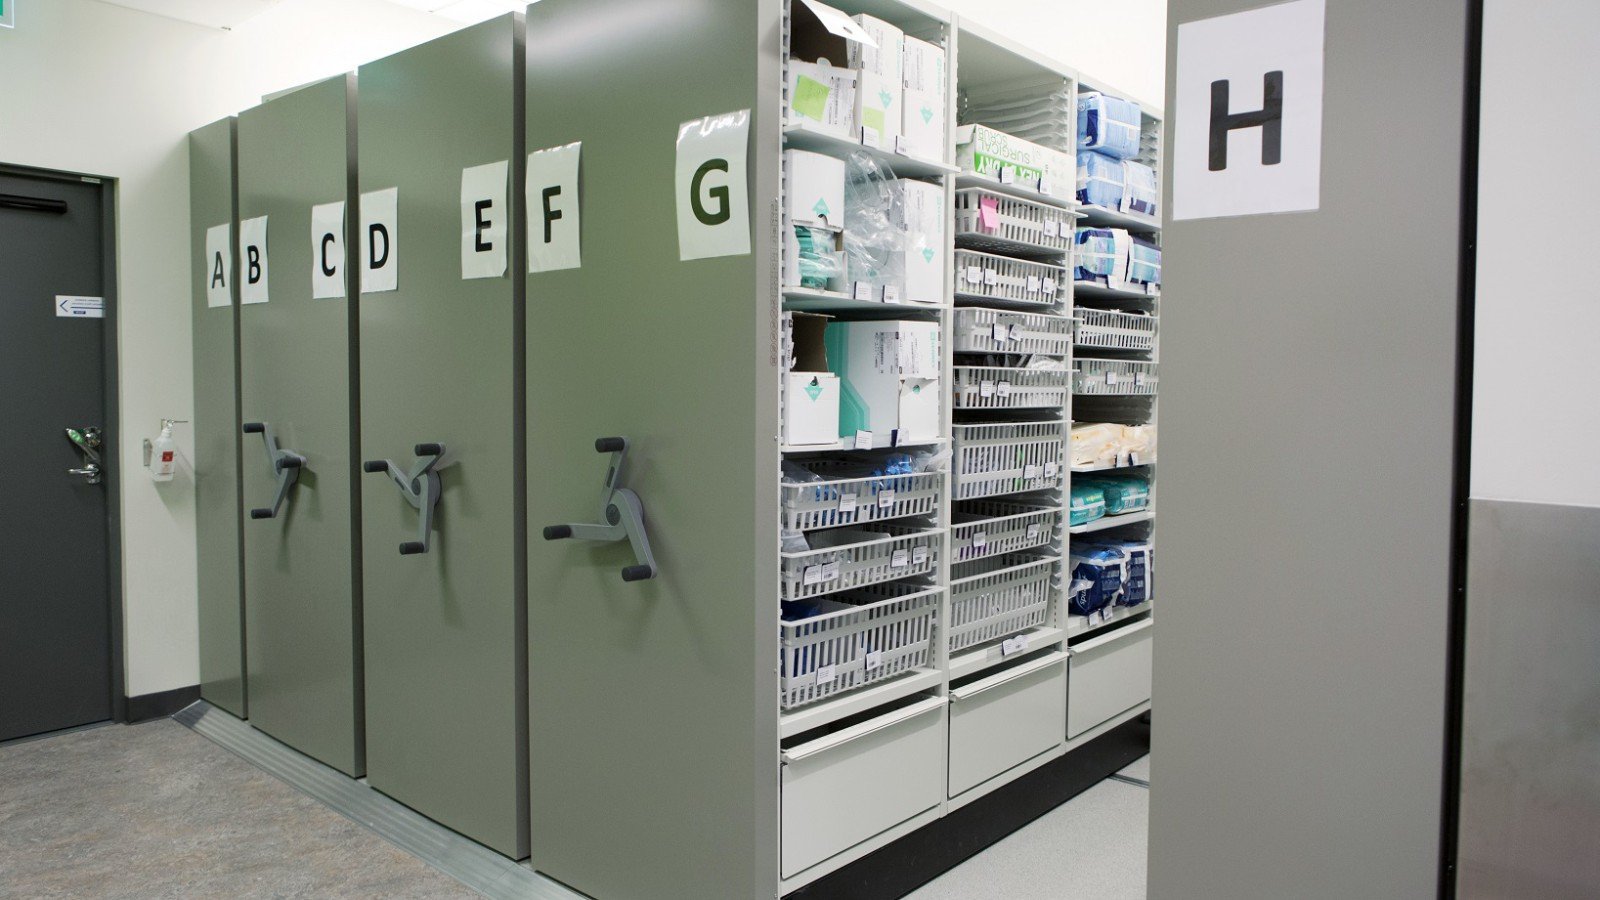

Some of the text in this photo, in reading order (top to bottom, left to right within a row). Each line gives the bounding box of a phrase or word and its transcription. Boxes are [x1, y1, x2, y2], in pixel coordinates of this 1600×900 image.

[978, 127, 1008, 147] SCRUB
[1208, 71, 1283, 172] H
[977, 137, 1030, 165] SURGICAL
[541, 185, 563, 244] F
[690, 158, 731, 226] G
[368, 223, 390, 270] D
[475, 198, 493, 253] E
[211, 252, 226, 289] A
[247, 244, 261, 285] B
[321, 233, 336, 277] C
